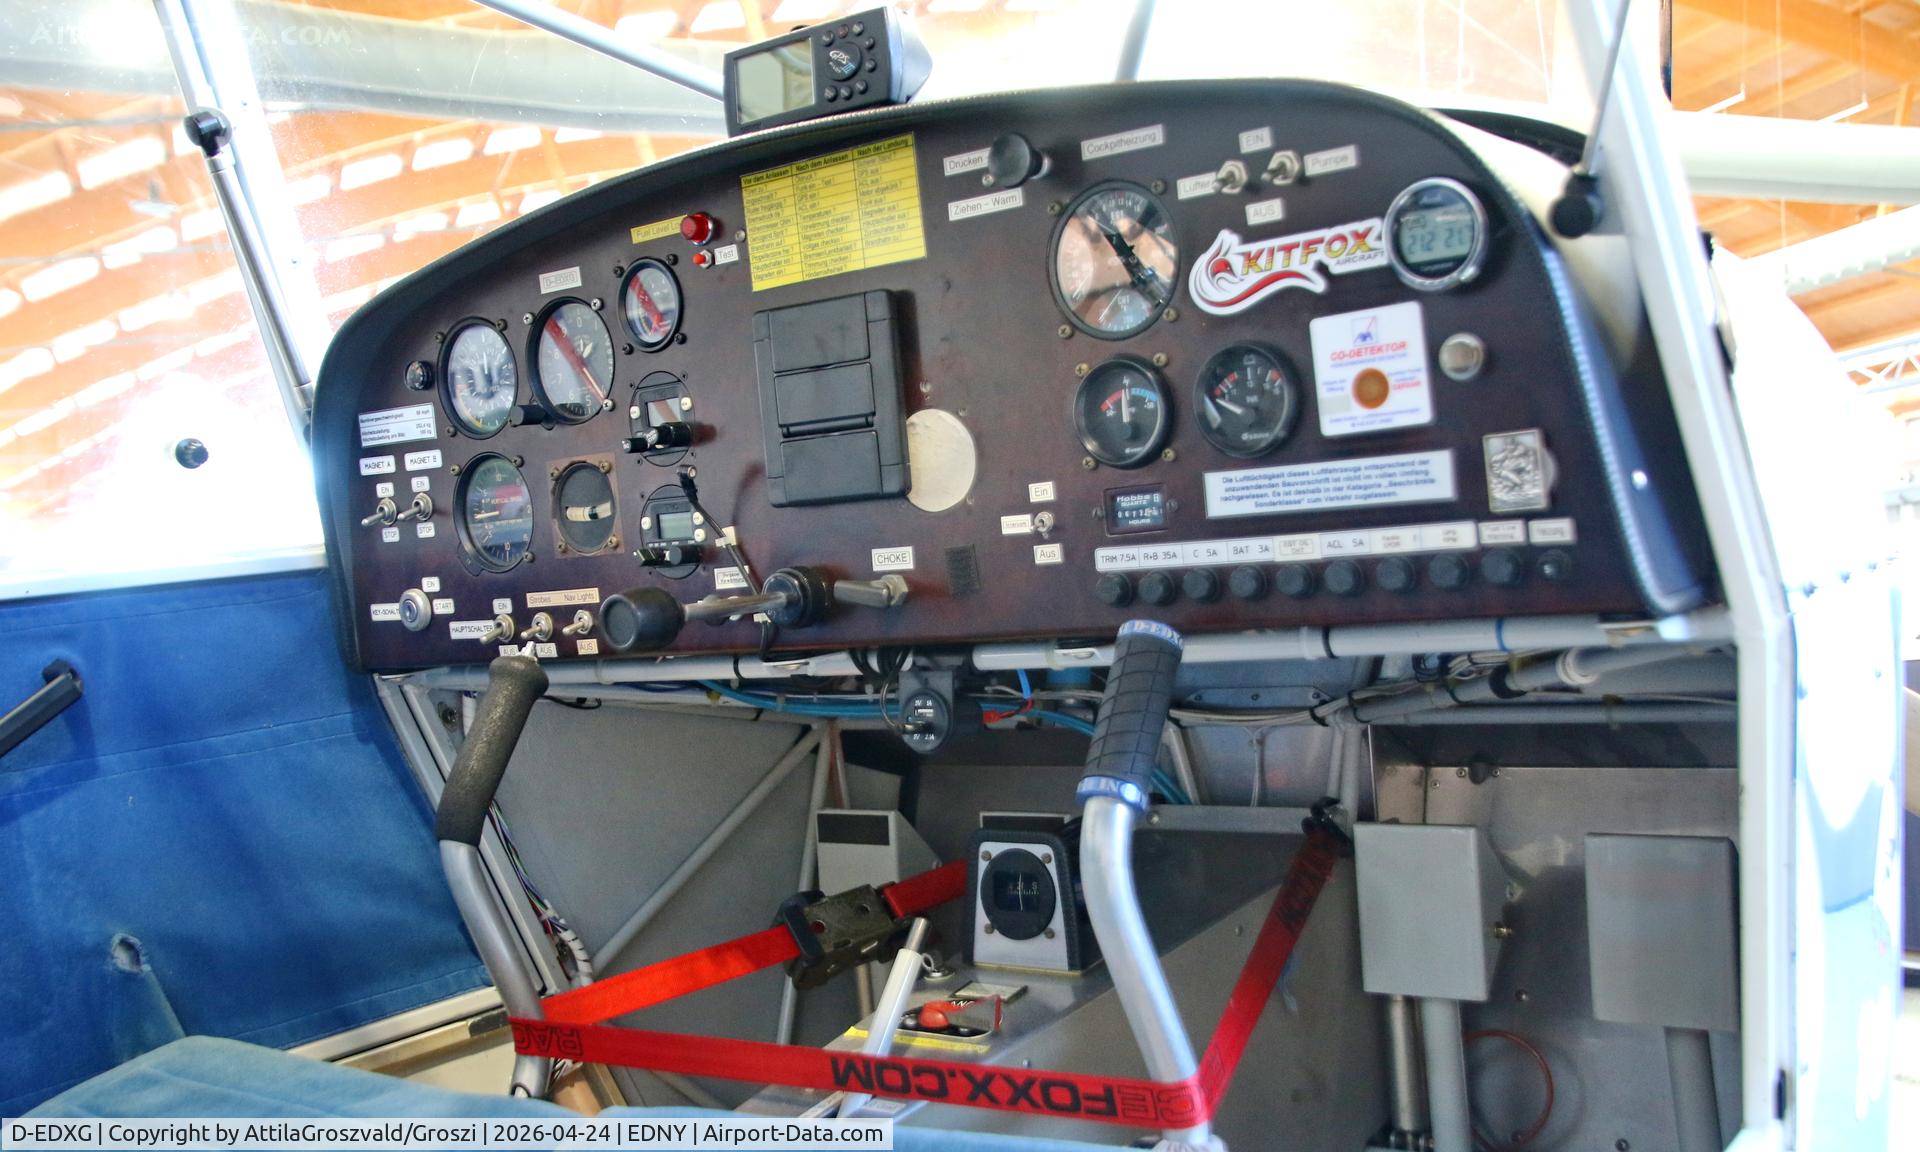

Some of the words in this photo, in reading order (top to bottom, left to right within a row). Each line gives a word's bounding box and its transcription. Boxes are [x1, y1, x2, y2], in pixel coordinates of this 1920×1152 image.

[1086, 131, 1158, 156] Cockpitheizung
[1245, 133, 1265, 148] EIN
[1310, 154, 1350, 169] Pumpe
[952, 200, 983, 216] Ziehen
[991, 193, 1018, 207] Warm
[1252, 204, 1276, 218] AUS
[717, 249, 734, 259] Test
[1235, 226, 1381, 277] KITFOX
[1334, 250, 1386, 267] AIRCRAFT
[1329, 341, 1409, 362] CO-DETEKTOR
[409, 456, 431, 465] MAGNET
[432, 455, 437, 463] B
[364, 461, 385, 470] MAGNET
[1222, 476, 1233, 484] Die
[1034, 487, 1048, 497] Ein
[1117, 494, 1151, 503] Hobbs
[384, 530, 398, 539] STOP
[418, 525, 433, 535] STOP
[1326, 539, 1344, 549] ACL
[1351, 537, 1365, 548] 5A
[876, 552, 908, 565] CHOKE
[1039, 549, 1056, 559] Aus
[1100, 554, 1118, 564] TRIM
[1119, 553, 1137, 563] 7.5A
[1162, 551, 1177, 560] 35A
[1193, 549, 1200, 559] C
[1207, 548, 1218, 558] 5A
[1232, 545, 1249, 555] BAT
[1258, 544, 1270, 554] 3A
[426, 580, 436, 589] EIN
[563, 593, 577, 602] Nav
[577, 591, 595, 602] Lights
[434, 600, 453, 611] START
[497, 602, 508, 611] EIN
[451, 625, 494, 634] HAUPTSCHALTER
[539, 645, 553, 655] AUS
[579, 642, 594, 652] AUS
